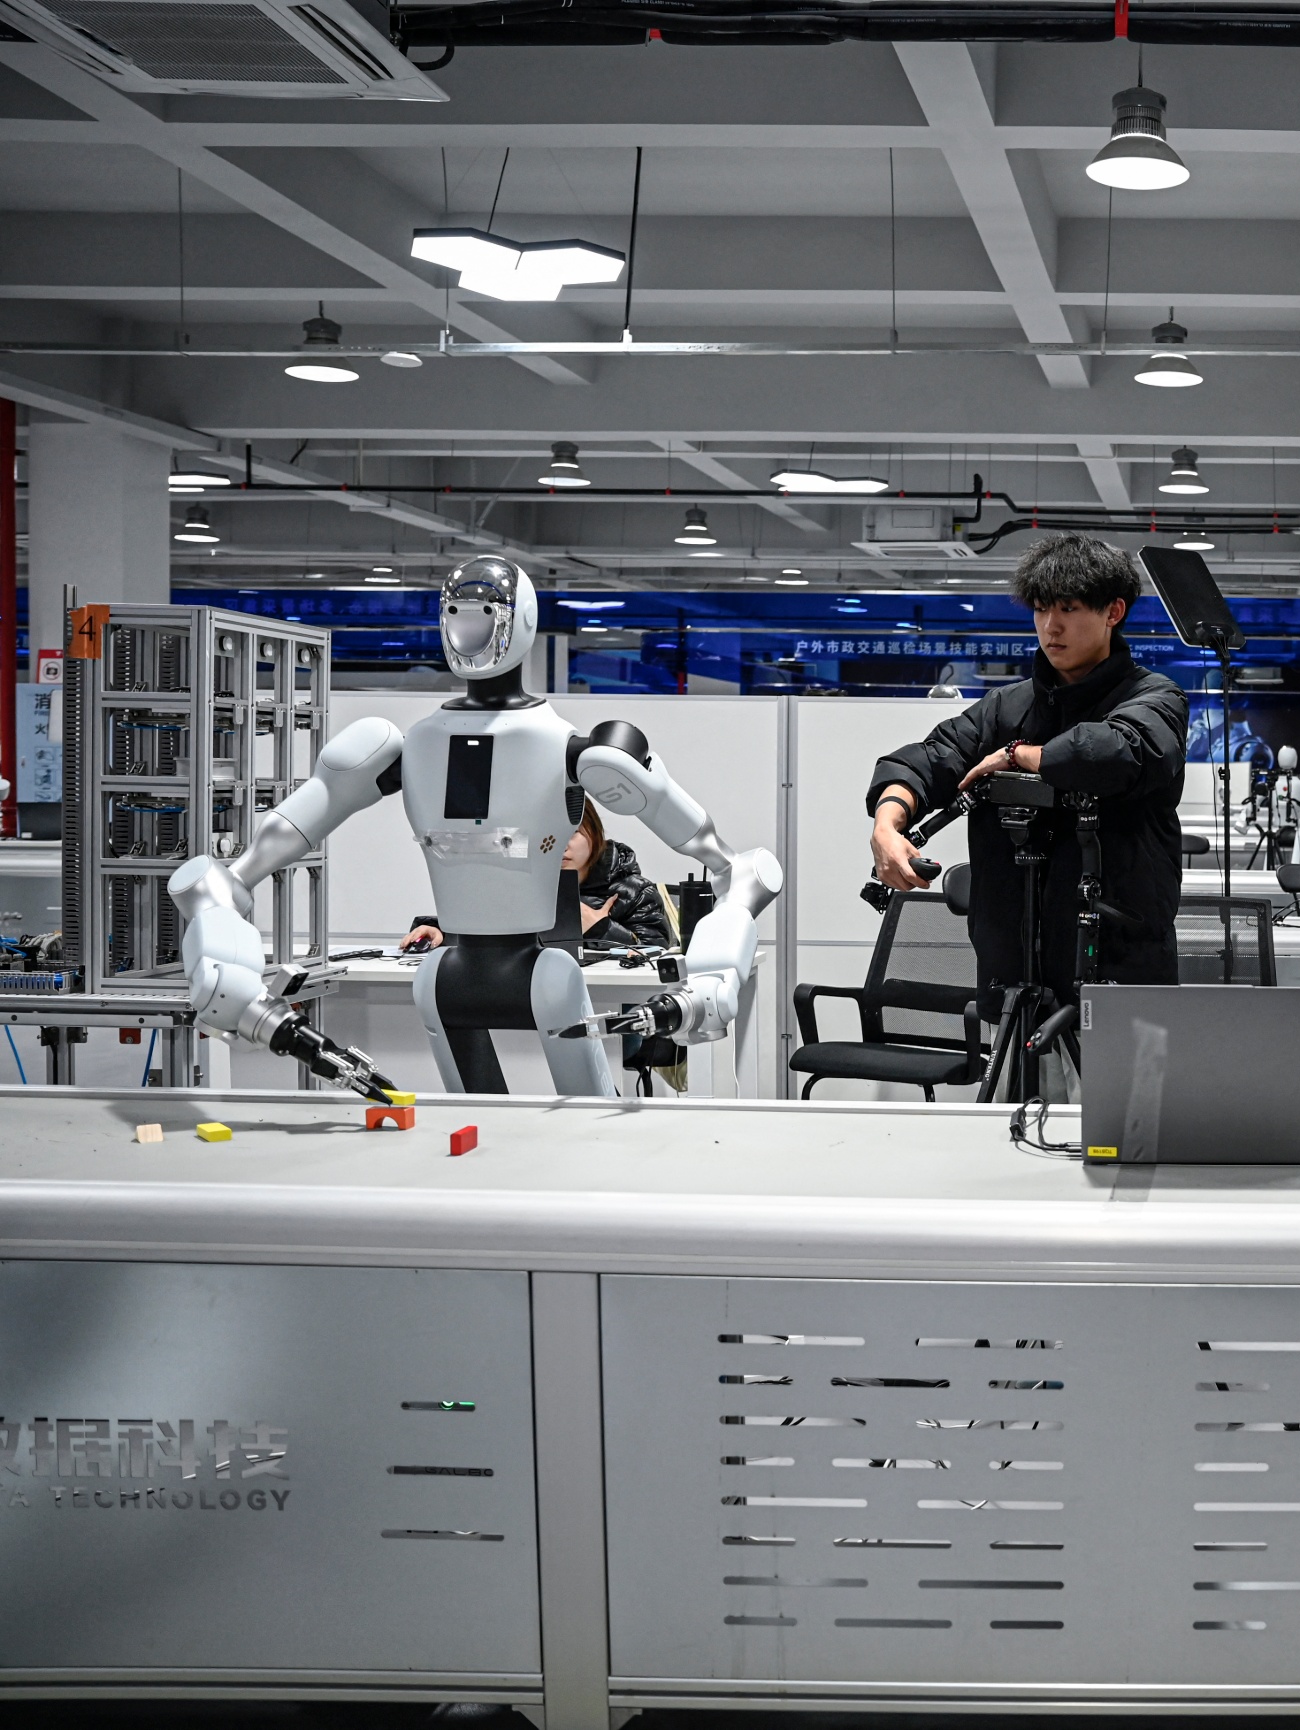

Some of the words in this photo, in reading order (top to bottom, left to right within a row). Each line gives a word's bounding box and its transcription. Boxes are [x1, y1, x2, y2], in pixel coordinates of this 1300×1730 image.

[78, 615, 97, 642] 4
[796, 639, 1025, 657] 户外市政交通巡检场景技能实训区
[595, 783, 632, 804] G1
[50, 1484, 291, 1512] TECHNOLOGY
